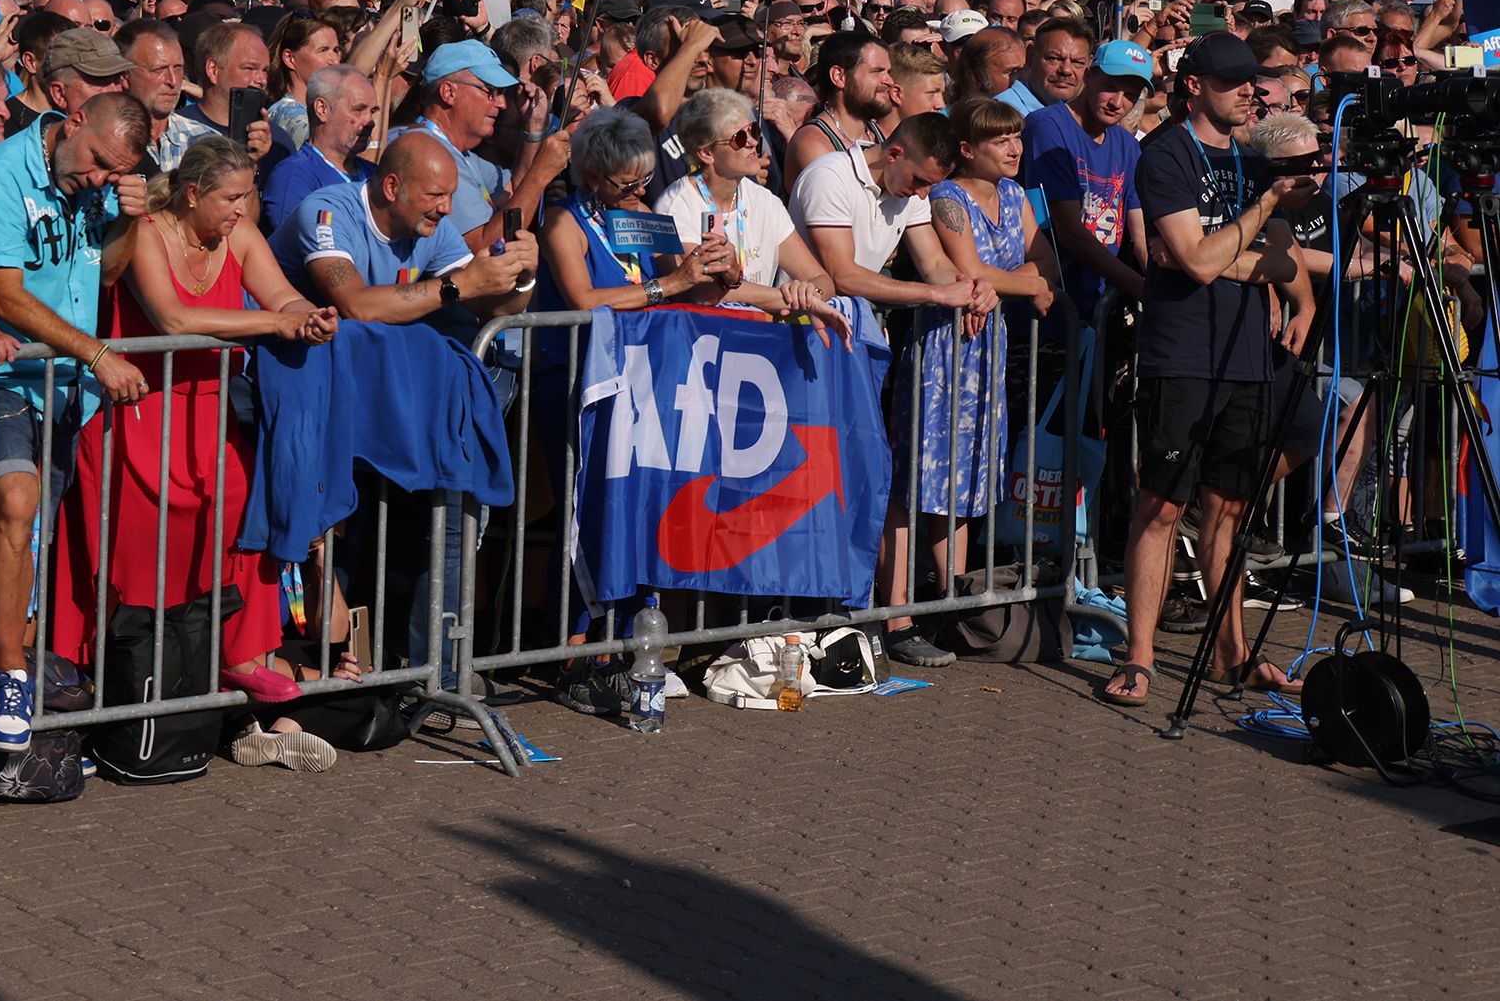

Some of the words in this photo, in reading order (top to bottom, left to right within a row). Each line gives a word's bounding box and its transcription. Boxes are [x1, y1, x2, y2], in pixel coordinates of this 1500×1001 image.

[1124, 48, 1144, 60] AfD
[615, 219, 635, 229] Kein
[636, 220, 675, 233] Fähnchen
[617, 234, 629, 243] im
[631, 233, 653, 244] Wind
[605, 335, 788, 479] AfD
